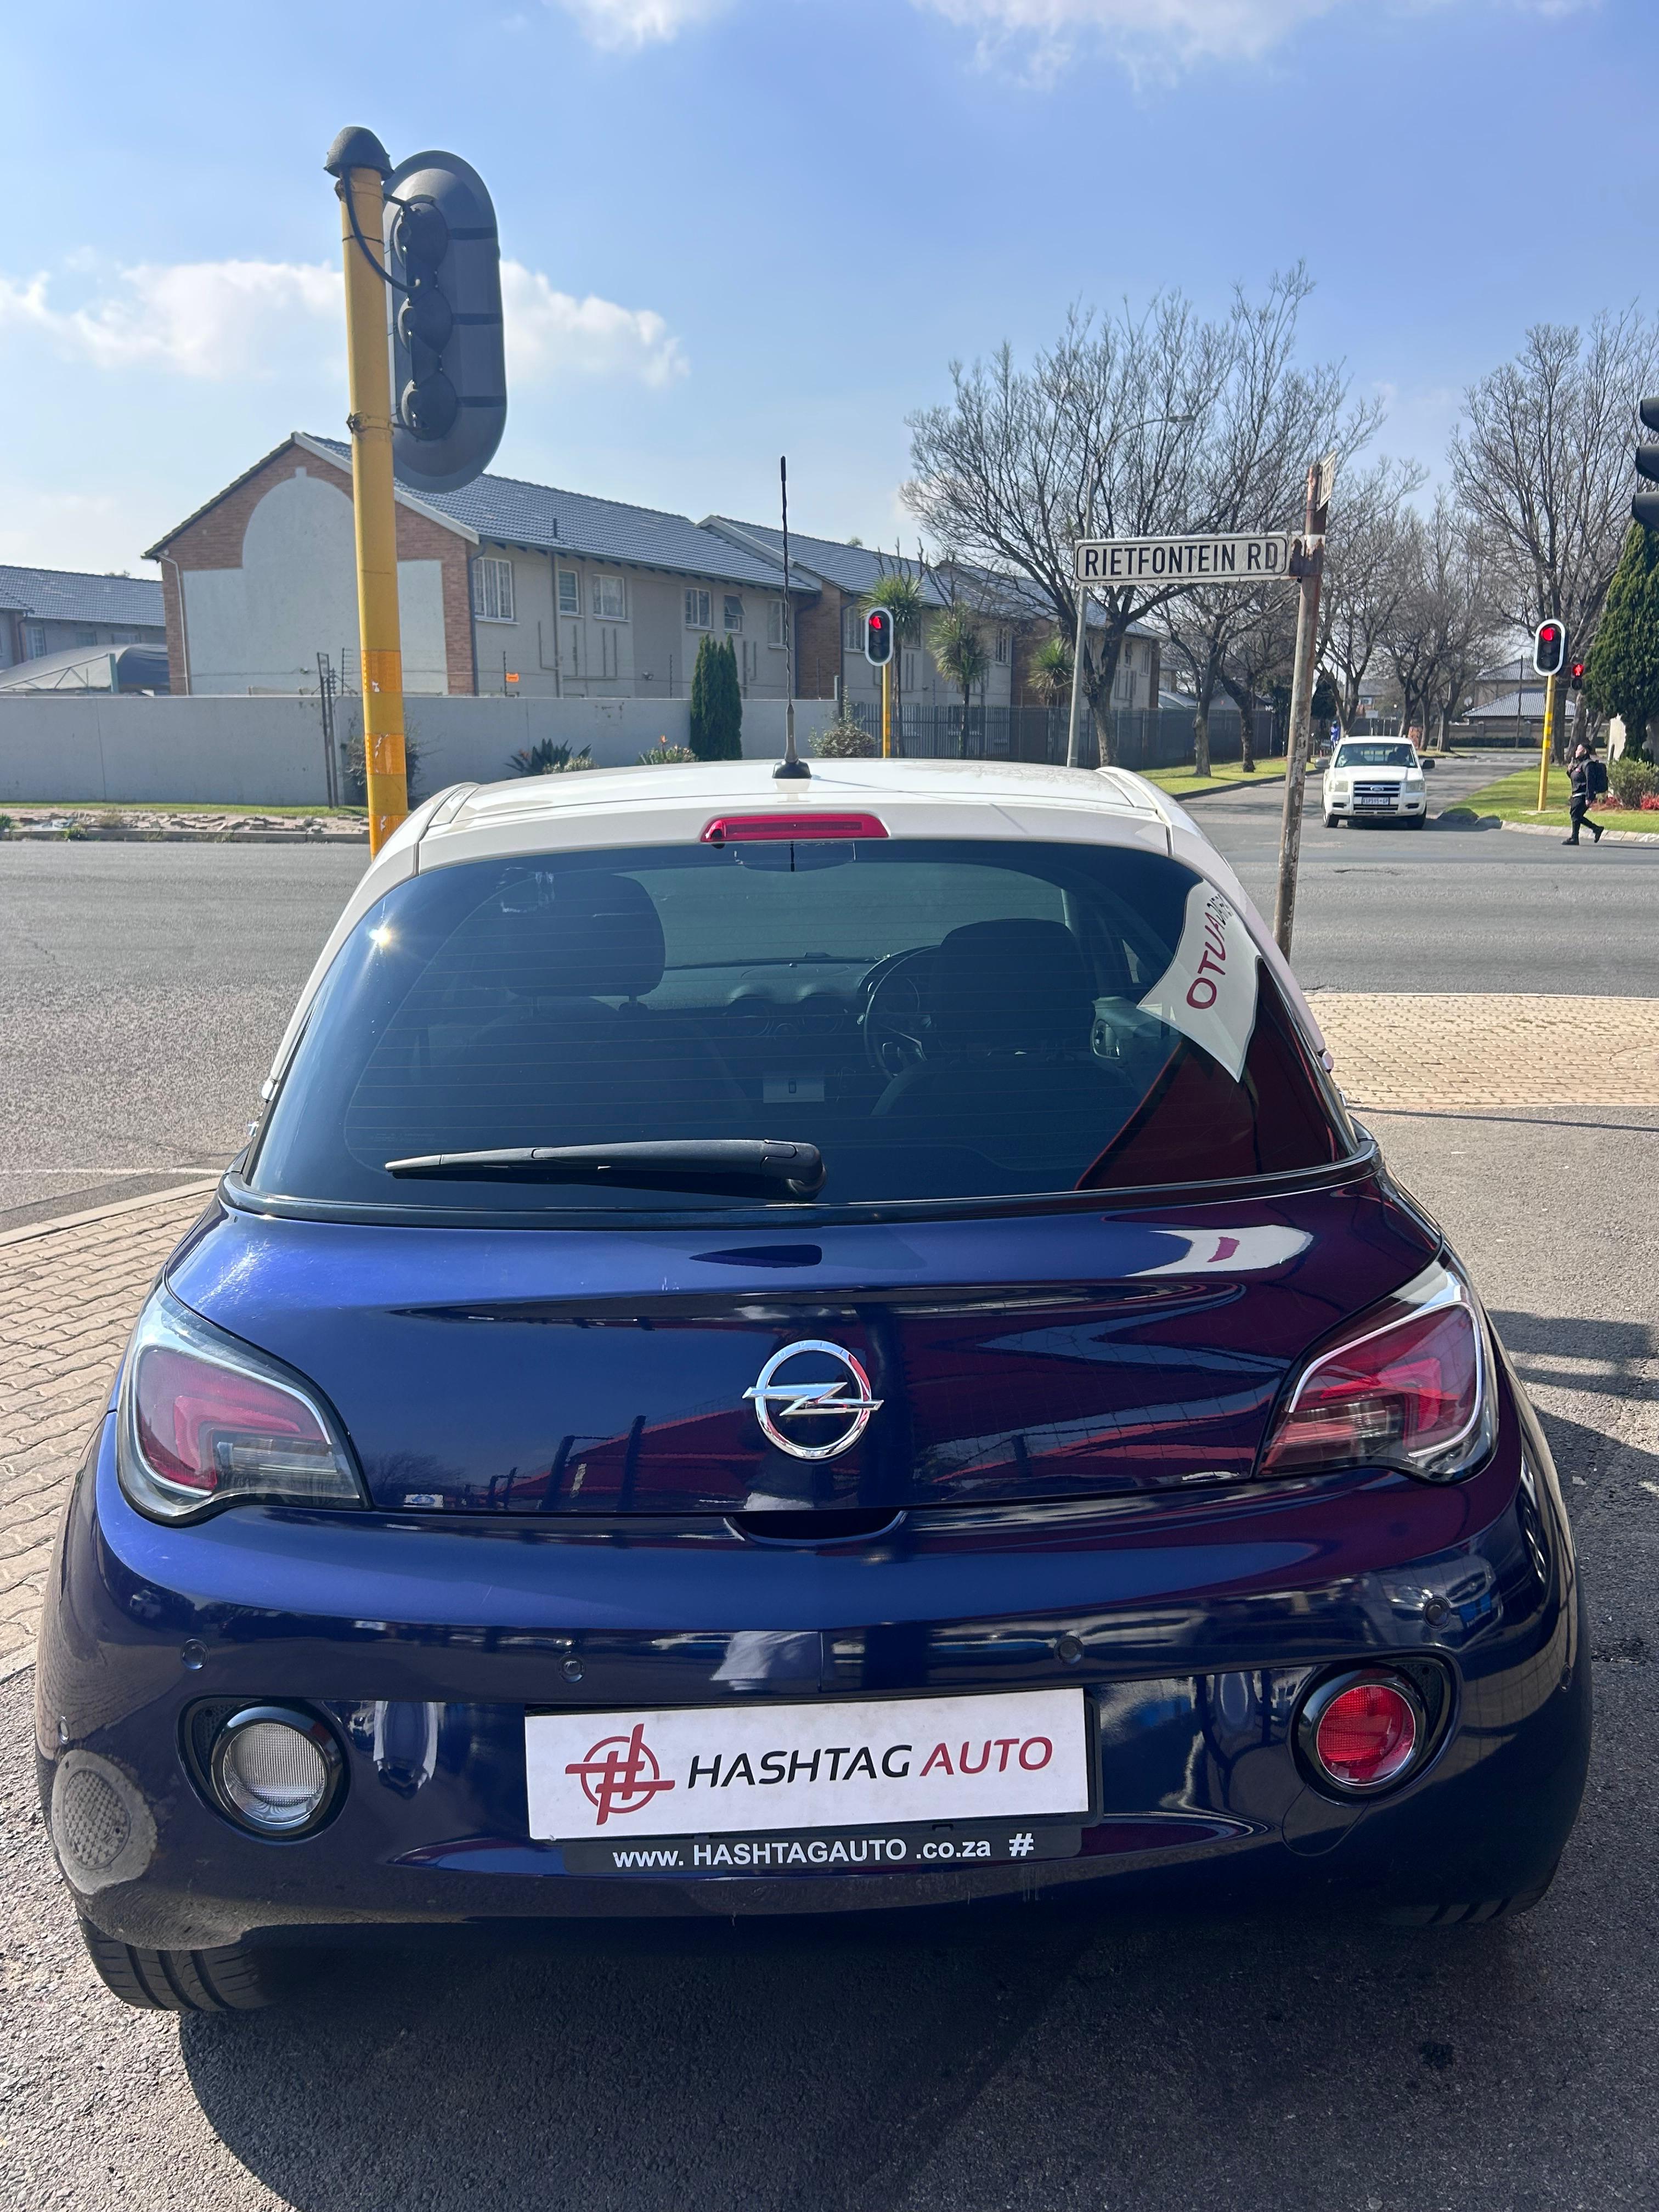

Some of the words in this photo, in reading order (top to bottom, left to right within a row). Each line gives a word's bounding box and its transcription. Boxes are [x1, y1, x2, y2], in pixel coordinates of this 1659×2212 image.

[1085, 543, 1236, 577] RIETFONTEIN
[1247, 539, 1279, 571] RD
[687, 1745, 912, 1789] HASHTAG
[919, 1736, 1053, 1777] AUTO
[693, 1838, 907, 1865] HASHTAGAUTO
[916, 1839, 991, 1859] .co.za
